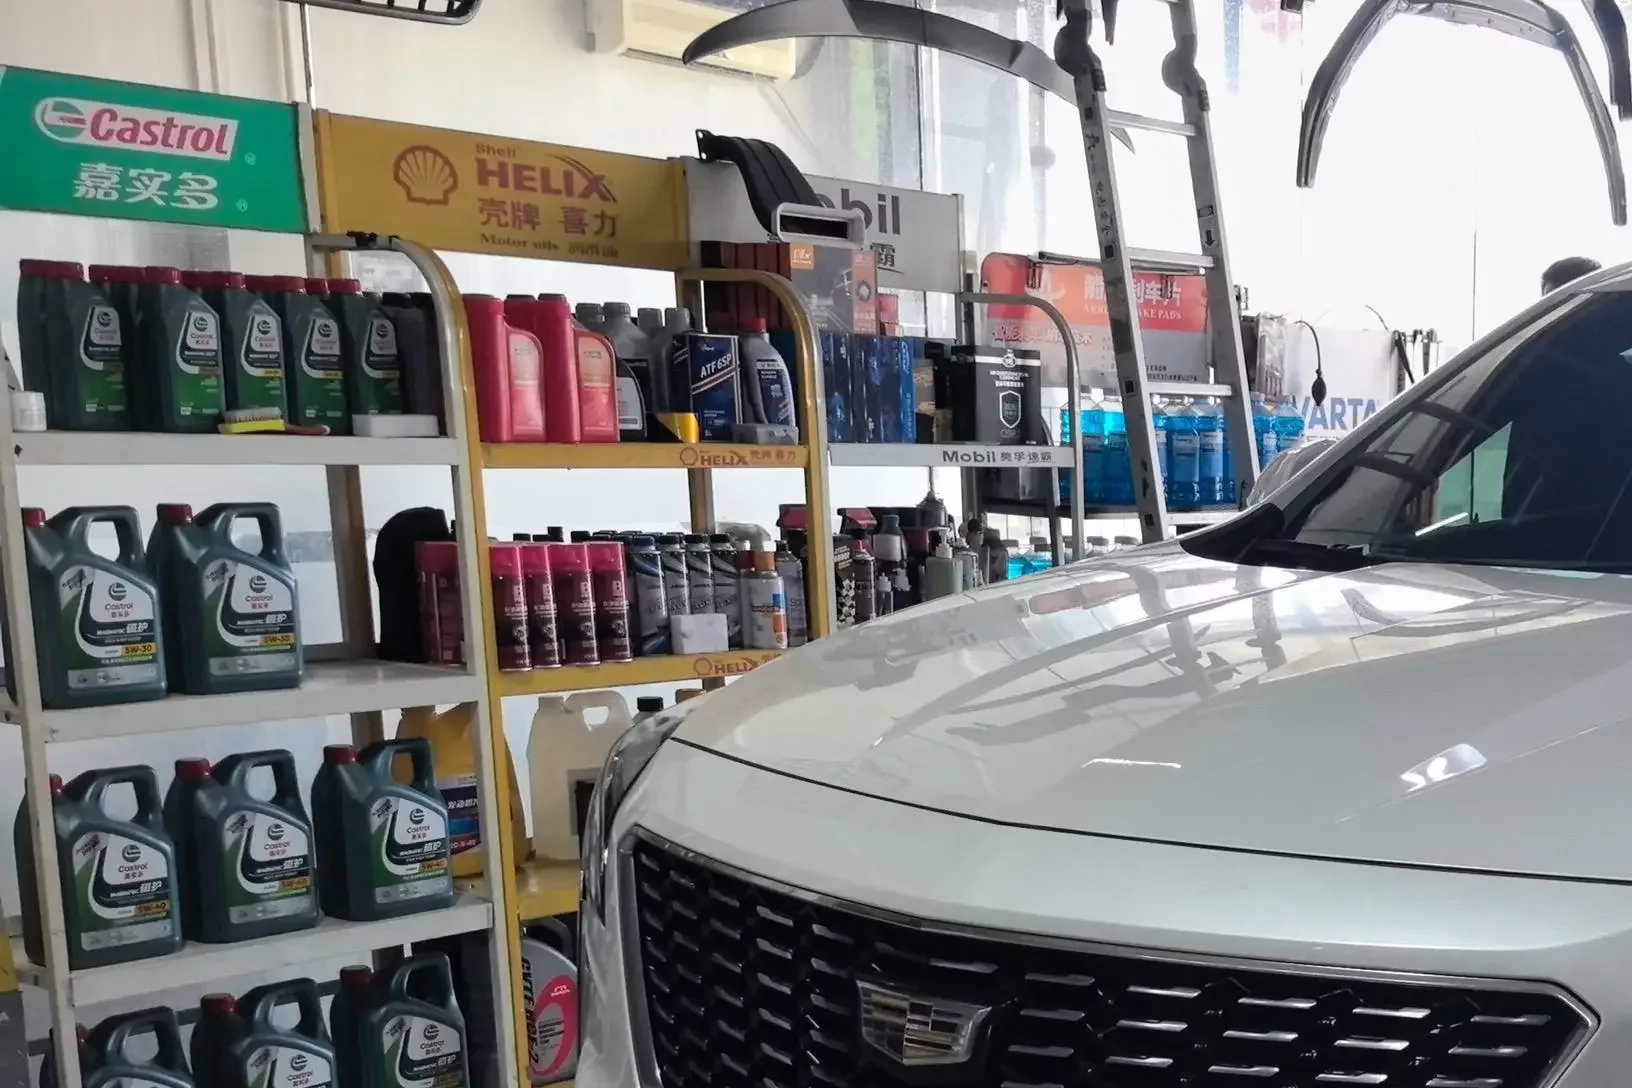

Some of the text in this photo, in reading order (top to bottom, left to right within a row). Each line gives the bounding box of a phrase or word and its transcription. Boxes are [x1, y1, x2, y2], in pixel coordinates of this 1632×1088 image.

[90, 108, 229, 155] Castrol
[475, 142, 517, 159] Shell
[73, 162, 219, 210] 嘉实多
[474, 157, 616, 203] HELIX
[478, 198, 620, 238] 壳牌 喜力
[817, 188, 901, 235] bil
[480, 233, 528, 250] Motor
[533, 240, 559, 251] oils
[1158, 309, 1182, 320] PADS
[700, 361, 717, 379] ATF
[701, 451, 749, 466] HELIX
[943, 450, 996, 463] Mobil
[245, 594, 273, 602] Castrol
[124, 644, 153, 655] 5W-30
[407, 826, 431, 834] Castrol
[264, 841, 291, 850] Castrol
[118, 863, 148, 873] Castrol
[420, 1040, 445, 1050] Castrol
[287, 1071, 313, 1081] Castrol
